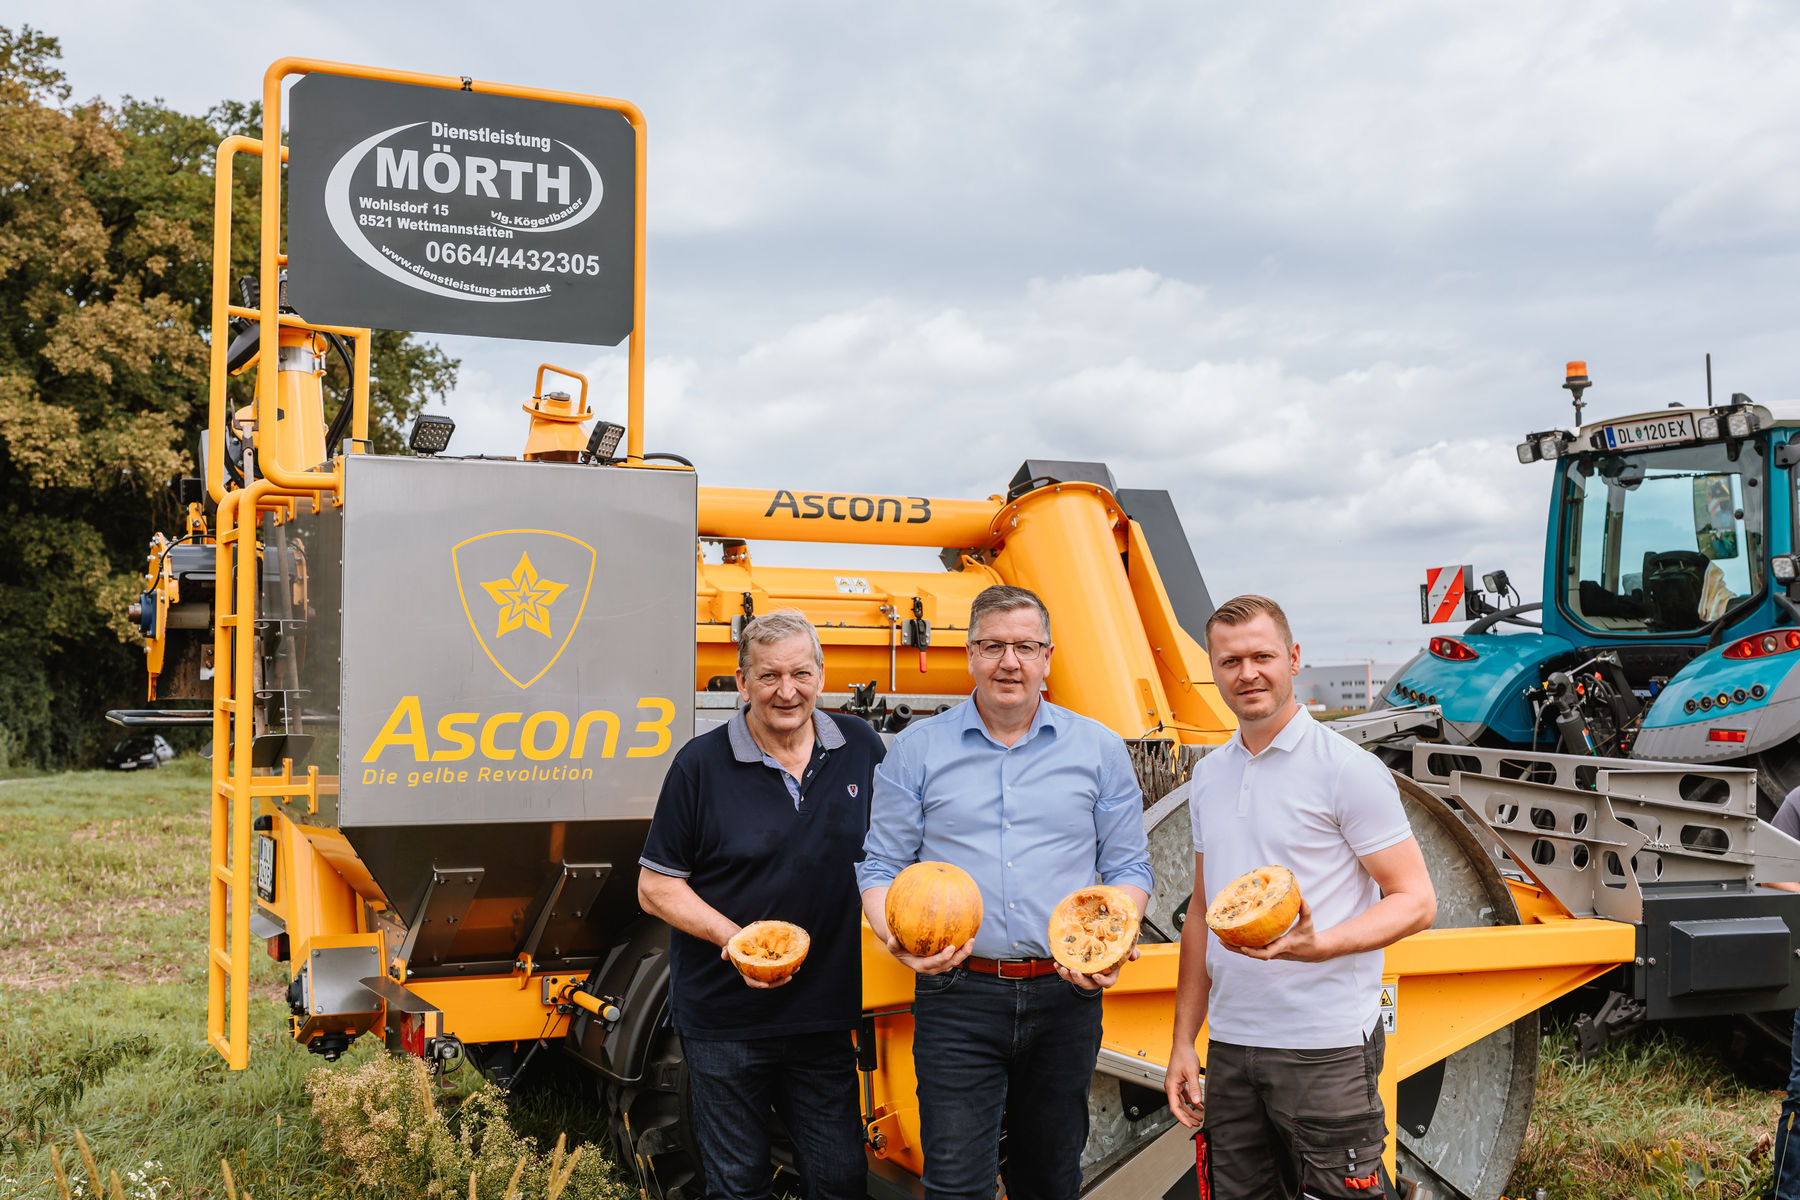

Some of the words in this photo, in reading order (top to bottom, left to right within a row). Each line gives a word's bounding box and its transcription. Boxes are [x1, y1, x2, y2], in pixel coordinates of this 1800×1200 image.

[431, 121, 551, 152] Dienstleistung
[376, 143, 571, 206] MÖRTH
[359, 196, 429, 215] Wohlsdorf
[432, 203, 450, 217] 15
[359, 214, 393, 229] 8521
[397, 217, 514, 239] Wettmannstätten
[381, 244, 552, 297] www.dienstleistung-mörth.at
[425, 241, 600, 276] 0664/4432305
[1618, 428, 1635, 444] DL
[1643, 423, 1667, 440] 120
[1668, 420, 1687, 438] EX
[362, 768, 398, 785] Die
[408, 767, 469, 787] gelbe
[477, 765, 593, 783] Revolution
